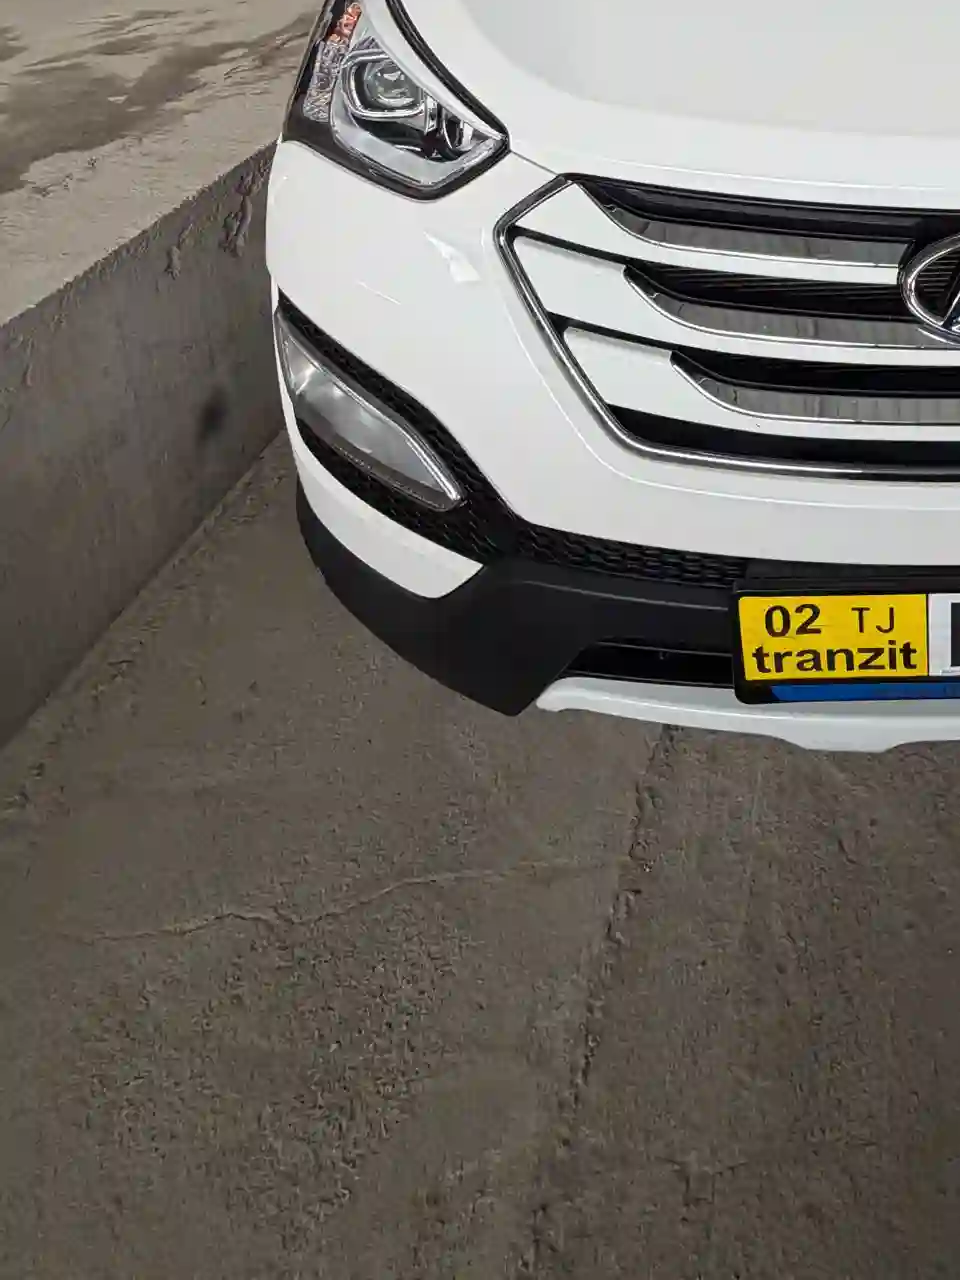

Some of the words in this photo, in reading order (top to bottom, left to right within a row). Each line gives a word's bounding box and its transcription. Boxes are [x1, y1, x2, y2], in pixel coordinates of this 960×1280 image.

[764, 603, 822, 638] 02
[851, 607, 895, 634] TJ
[752, 639, 917, 674] tranzit
